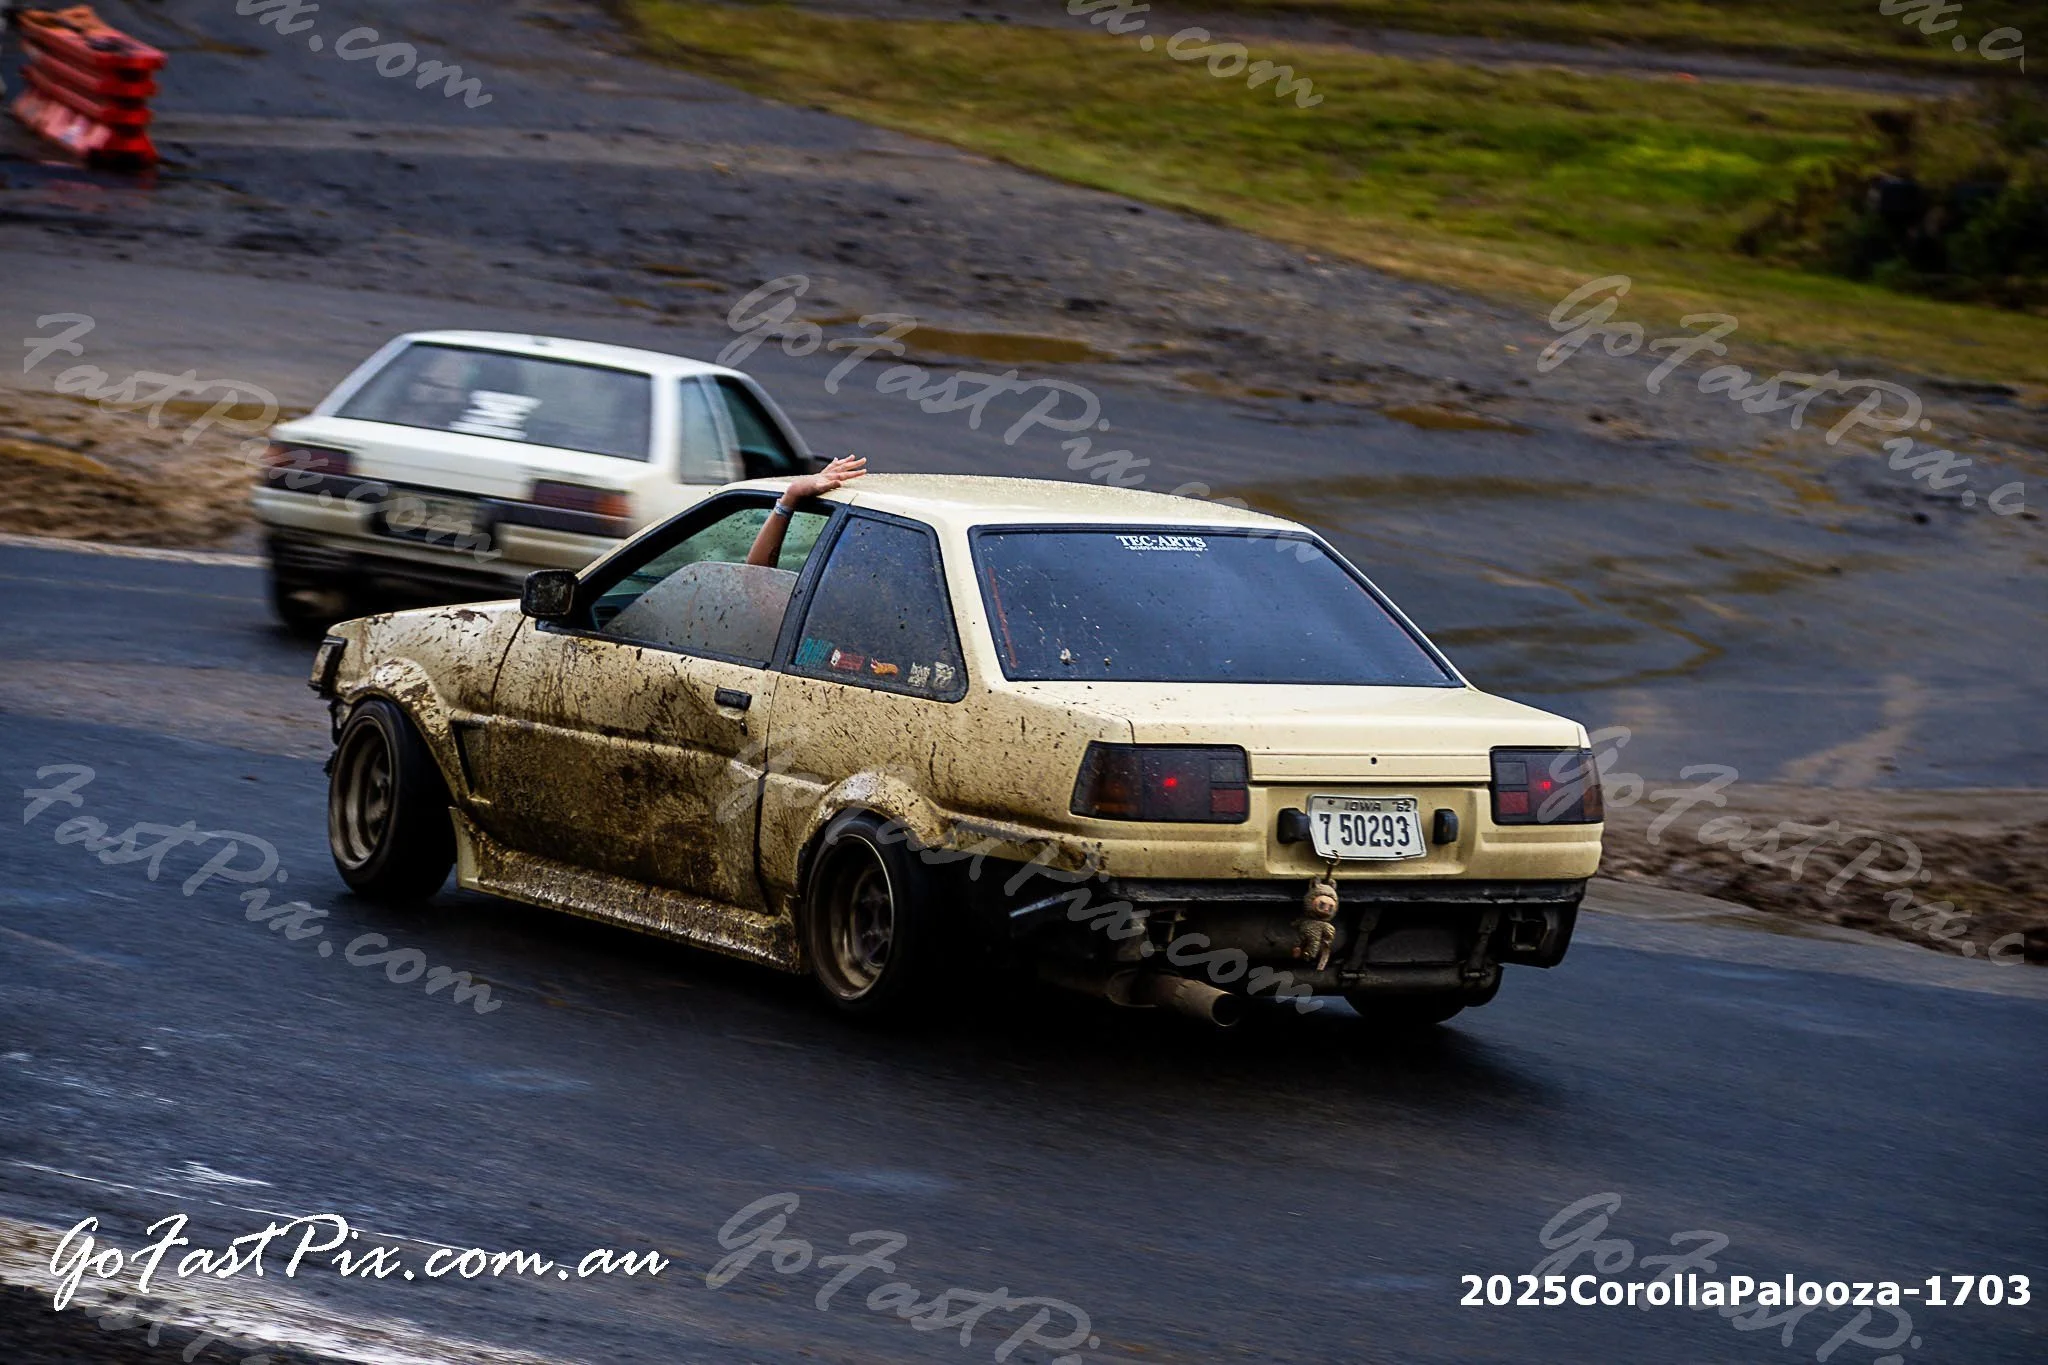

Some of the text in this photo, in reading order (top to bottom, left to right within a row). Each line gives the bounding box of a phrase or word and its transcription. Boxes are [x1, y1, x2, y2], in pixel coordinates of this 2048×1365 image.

[1344, 801, 1382, 812] IOWA
[1319, 813, 1410, 847] 7 50293
